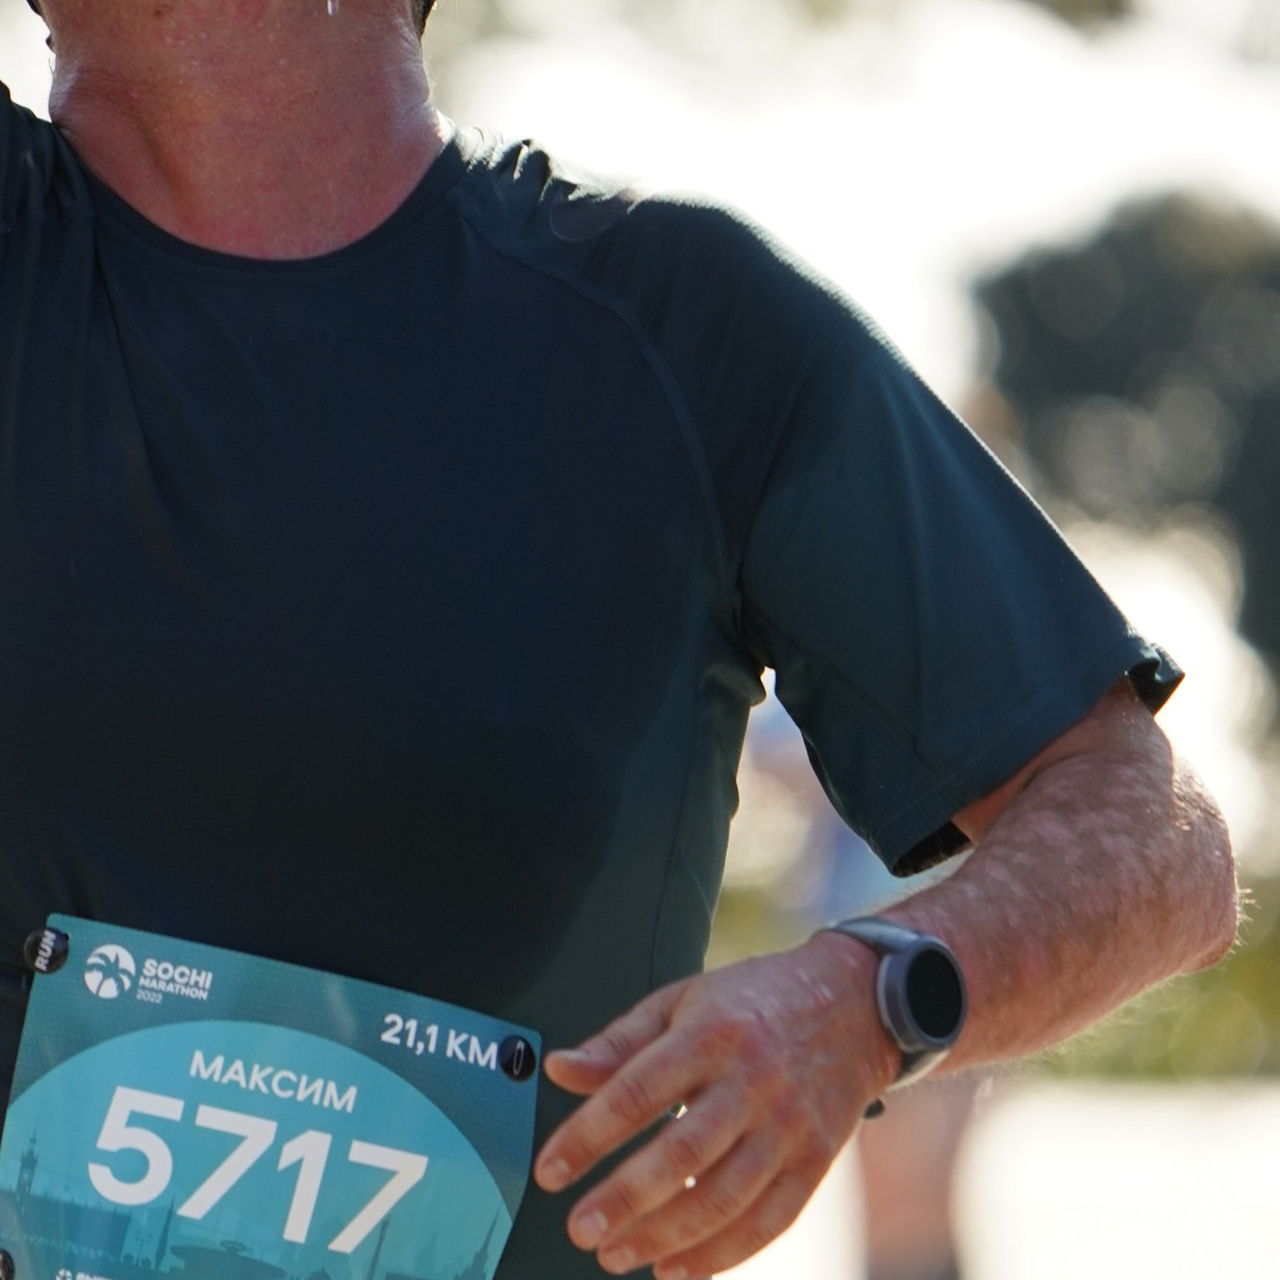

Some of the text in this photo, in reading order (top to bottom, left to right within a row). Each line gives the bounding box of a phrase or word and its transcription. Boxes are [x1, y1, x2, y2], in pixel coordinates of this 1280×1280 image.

[34, 929, 57, 972] RUN
[138, 976, 209, 1001] MARATHON
[142, 958, 213, 990] SOCHI
[136, 988, 163, 1005] 2022
[380, 1012, 439, 1056] 21,1
[190, 1050, 357, 1114] МАКСИМ
[87, 1085, 429, 1255] 5717
